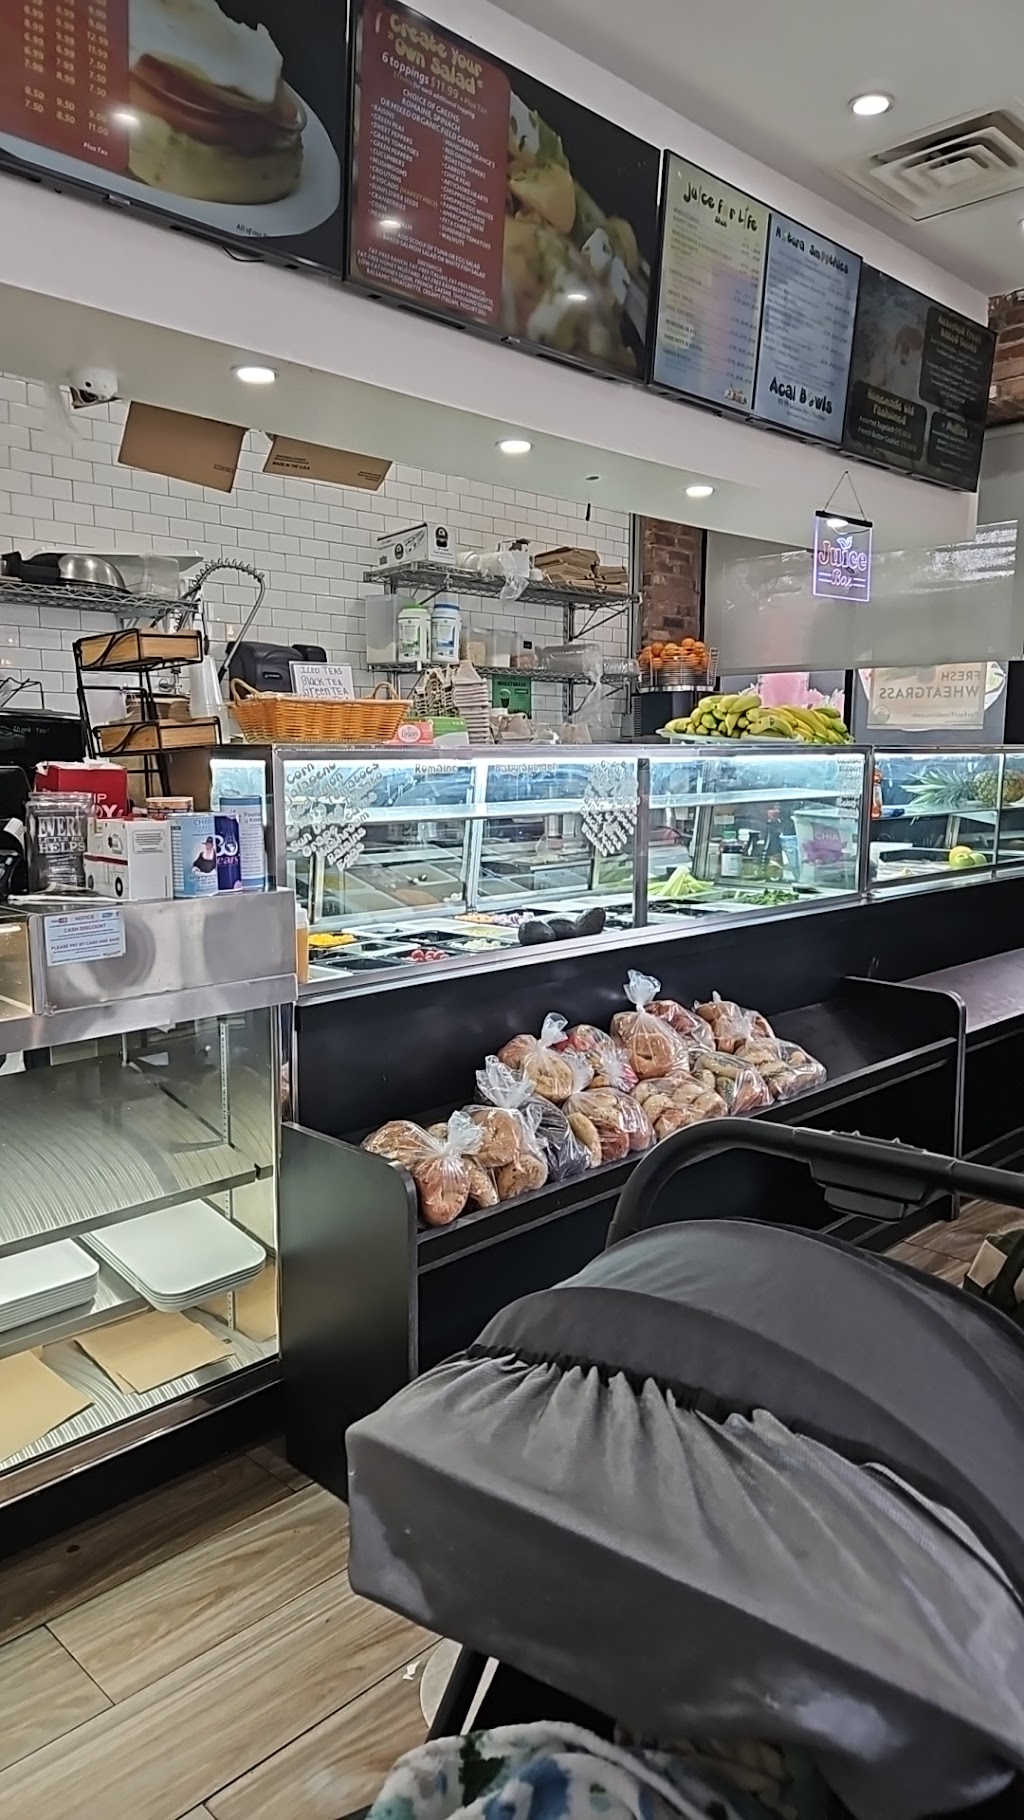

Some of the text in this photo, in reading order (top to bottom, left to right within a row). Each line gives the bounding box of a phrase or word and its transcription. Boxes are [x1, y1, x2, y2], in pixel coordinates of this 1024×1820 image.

[390, 14, 482, 77] Create Your
[395, 38, 426, 69] Own
[430, 57, 476, 95] Salad
[89, 71, 106, 84] 7.50
[381, 51, 389, 63] 6
[389, 55, 430, 85] toppings
[430, 76, 459, 99] $11.99
[89, 84, 107, 97] 7.50
[25, 99, 44, 113] 7.50
[403, 88, 436, 110] CHOICE OF
[456, 104, 476, 120] topping
[88, 122, 109, 136] 11.00
[380, 97, 480, 152] OR MIXED ORGANIC FIELD GREENS
[391, 121, 405, 133] PEAS
[433, 113, 460, 132] SPINACH
[391, 130, 413, 145] PEPPERS
[83, 142, 108, 156] Plus Tax
[391, 138, 420, 157] TOMATOES
[391, 147, 413, 163] PEPPERS
[444, 139, 472, 157] MANDARIN
[444, 147, 472, 164] RED ONION
[372, 148, 405, 168] CUCUMBERS
[372, 157, 407, 177] MUSHROOMS
[372, 165, 402, 183] CROUTONS
[444, 154, 486, 179] ROASTED PEPPERS
[444, 162, 467, 178] CARROTS
[371, 174, 399, 191] AVOCADO
[459, 177, 472, 188] PEAS
[443, 178, 489, 204] ARTICHOKE HEARTS
[443, 186, 477, 206] CHOPPED EGG
[442, 193, 494, 222] CHOPPED EGG WHITES
[441, 216, 454, 227] FETA
[442, 209, 468, 225] AMERICAN
[465, 259, 481, 270] SALAD
[769, 376, 796, 401] Acai
[819, 540, 867, 571] Juice
[301, 666, 343, 675] ICED TEAS
[325, 678, 343, 686] TEA
[331, 686, 349, 695] TEA
[286, 762, 315, 785] Corn
[414, 763, 459, 774] Romaine
[38, 815, 83, 837] EVERY
[814, 832, 840, 841] CHIA
[39, 842, 86, 853] HELPS
[79, 923, 106, 931] DISCOUNT
